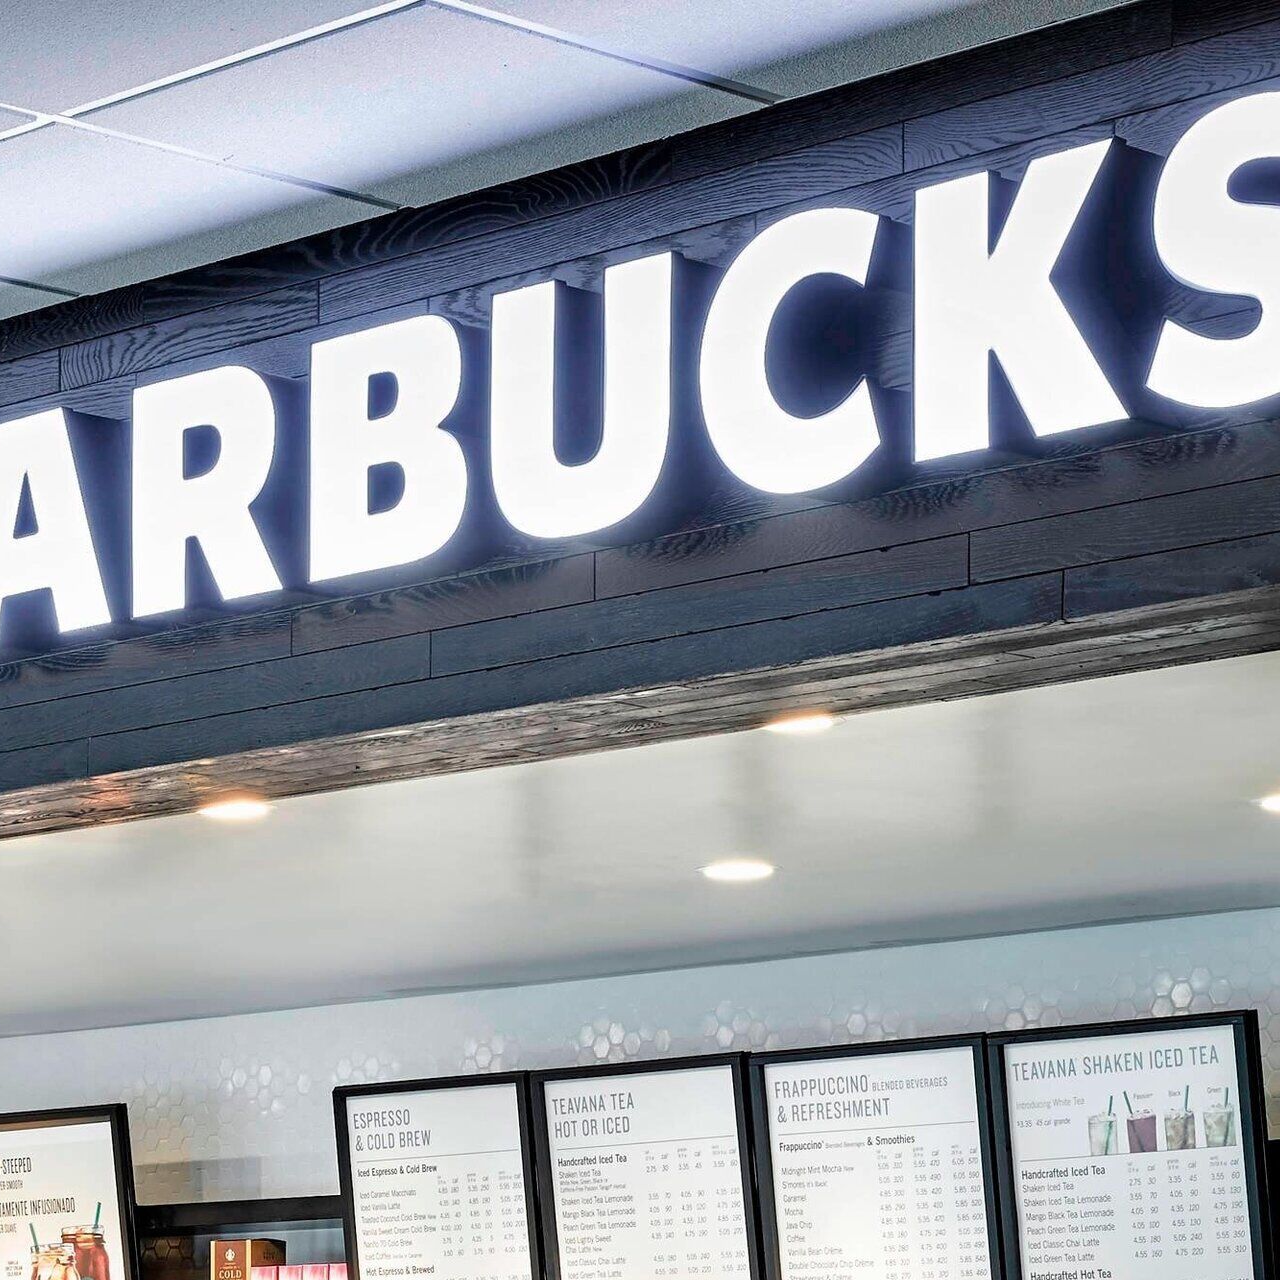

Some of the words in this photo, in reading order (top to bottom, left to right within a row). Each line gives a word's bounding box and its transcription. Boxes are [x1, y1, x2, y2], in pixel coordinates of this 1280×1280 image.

[1012, 1058, 1077, 1082] TEAVANA
[1084, 1052, 1144, 1076] SHAKEN
[1150, 1048, 1184, 1070] ICED
[1192, 1045, 1219, 1064] TEA
[774, 1074, 869, 1099] FRAPPUCCINO
[872, 1080, 904, 1092] BLENDED
[906, 1076, 948, 1090] BEVERAGES
[552, 1095, 606, 1115] TEAVANA
[610, 1092, 634, 1110] TEA
[778, 1106, 788, 1123] &
[792, 1098, 890, 1122] REFRESHMENT
[354, 1109, 410, 1130] ESPRESSO
[555, 1120, 578, 1138] HOT
[582, 1118, 598, 1136] OR
[602, 1116, 630, 1134] ICED
[356, 1135, 364, 1151] &
[368, 1132, 395, 1150] COLD
[400, 1130, 432, 1148] BREW
[867, 1136, 873, 1146] &
[875, 1134, 915, 1146] Smoothies
[557, 1156, 597, 1167] Handcrafted
[598, 1155, 613, 1164] Iced
[615, 1154, 627, 1164] Tea
[357, 1169, 370, 1178] Iced
[371, 1167, 398, 1177] Espresso
[406, 1166, 420, 1175] Cold
[421, 1164, 437, 1174] Brew
[1021, 1168, 1068, 1180] Handcrafted
[1071, 1167, 1088, 1178] Iced
[1092, 1167, 1105, 1176] Tea
[1022, 1183, 1045, 1193] Shaken
[1047, 1182, 1061, 1192] Iced
[1062, 1182, 1074, 1191] Tea
[30, 1198, 76, 1216] INFUSIONADO
[561, 1198, 580, 1206] Shaken
[604, 1195, 633, 1204] Lemonade
[1023, 1197, 1046, 1207] Shaken
[1048, 1197, 1062, 1206] Iced
[1064, 1196, 1075, 1205] Tea
[1076, 1194, 1111, 1204] Lemonade
[1025, 1212, 1046, 1223] Mango
[1048, 1211, 1066, 1221] Black
[1067, 1210, 1078, 1220] Tea
[1079, 1208, 1114, 1219] Lemonade
[1026, 1226, 1046, 1236] Peach
[1047, 1225, 1065, 1235] Green
[1068, 1225, 1079, 1234] Tea
[1080, 1223, 1115, 1233] Lemonade
[1027, 1241, 1041, 1249] Iced
[1042, 1240, 1064, 1249] Classic
[1066, 1239, 1080, 1248] Chai
[1082, 1238, 1100, 1247] Latte
[1028, 1255, 1042, 1264] Iced
[1043, 1254, 1062, 1263] Green
[1064, 1254, 1076, 1262] Tea
[1077, 1253, 1094, 1262] Latte
[220, 1270, 242, 1278] COLD
[366, 1268, 376, 1276] Hot
[378, 1267, 404, 1276] Espresso
[405, 1266, 410, 1274] &
[412, 1266, 434, 1274] Brewed
[1080, 1270, 1095, 1280] Hot
[1097, 1269, 1112, 1279] Tea
